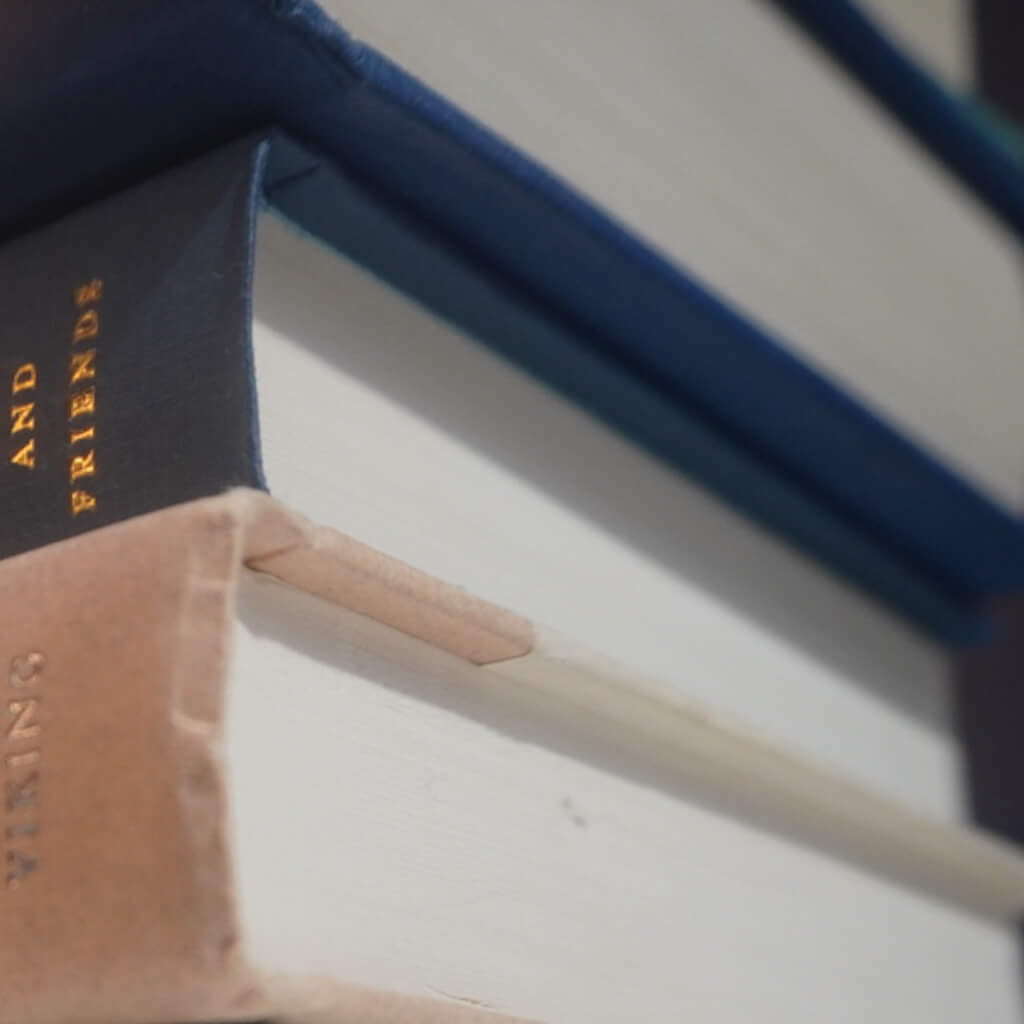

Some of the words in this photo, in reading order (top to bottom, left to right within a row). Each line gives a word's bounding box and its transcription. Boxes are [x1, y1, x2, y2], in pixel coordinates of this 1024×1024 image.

[10, 362, 38, 470] AND
[70, 278, 104, 516] FRIENDS
[3, 650, 43, 889] VIKING
